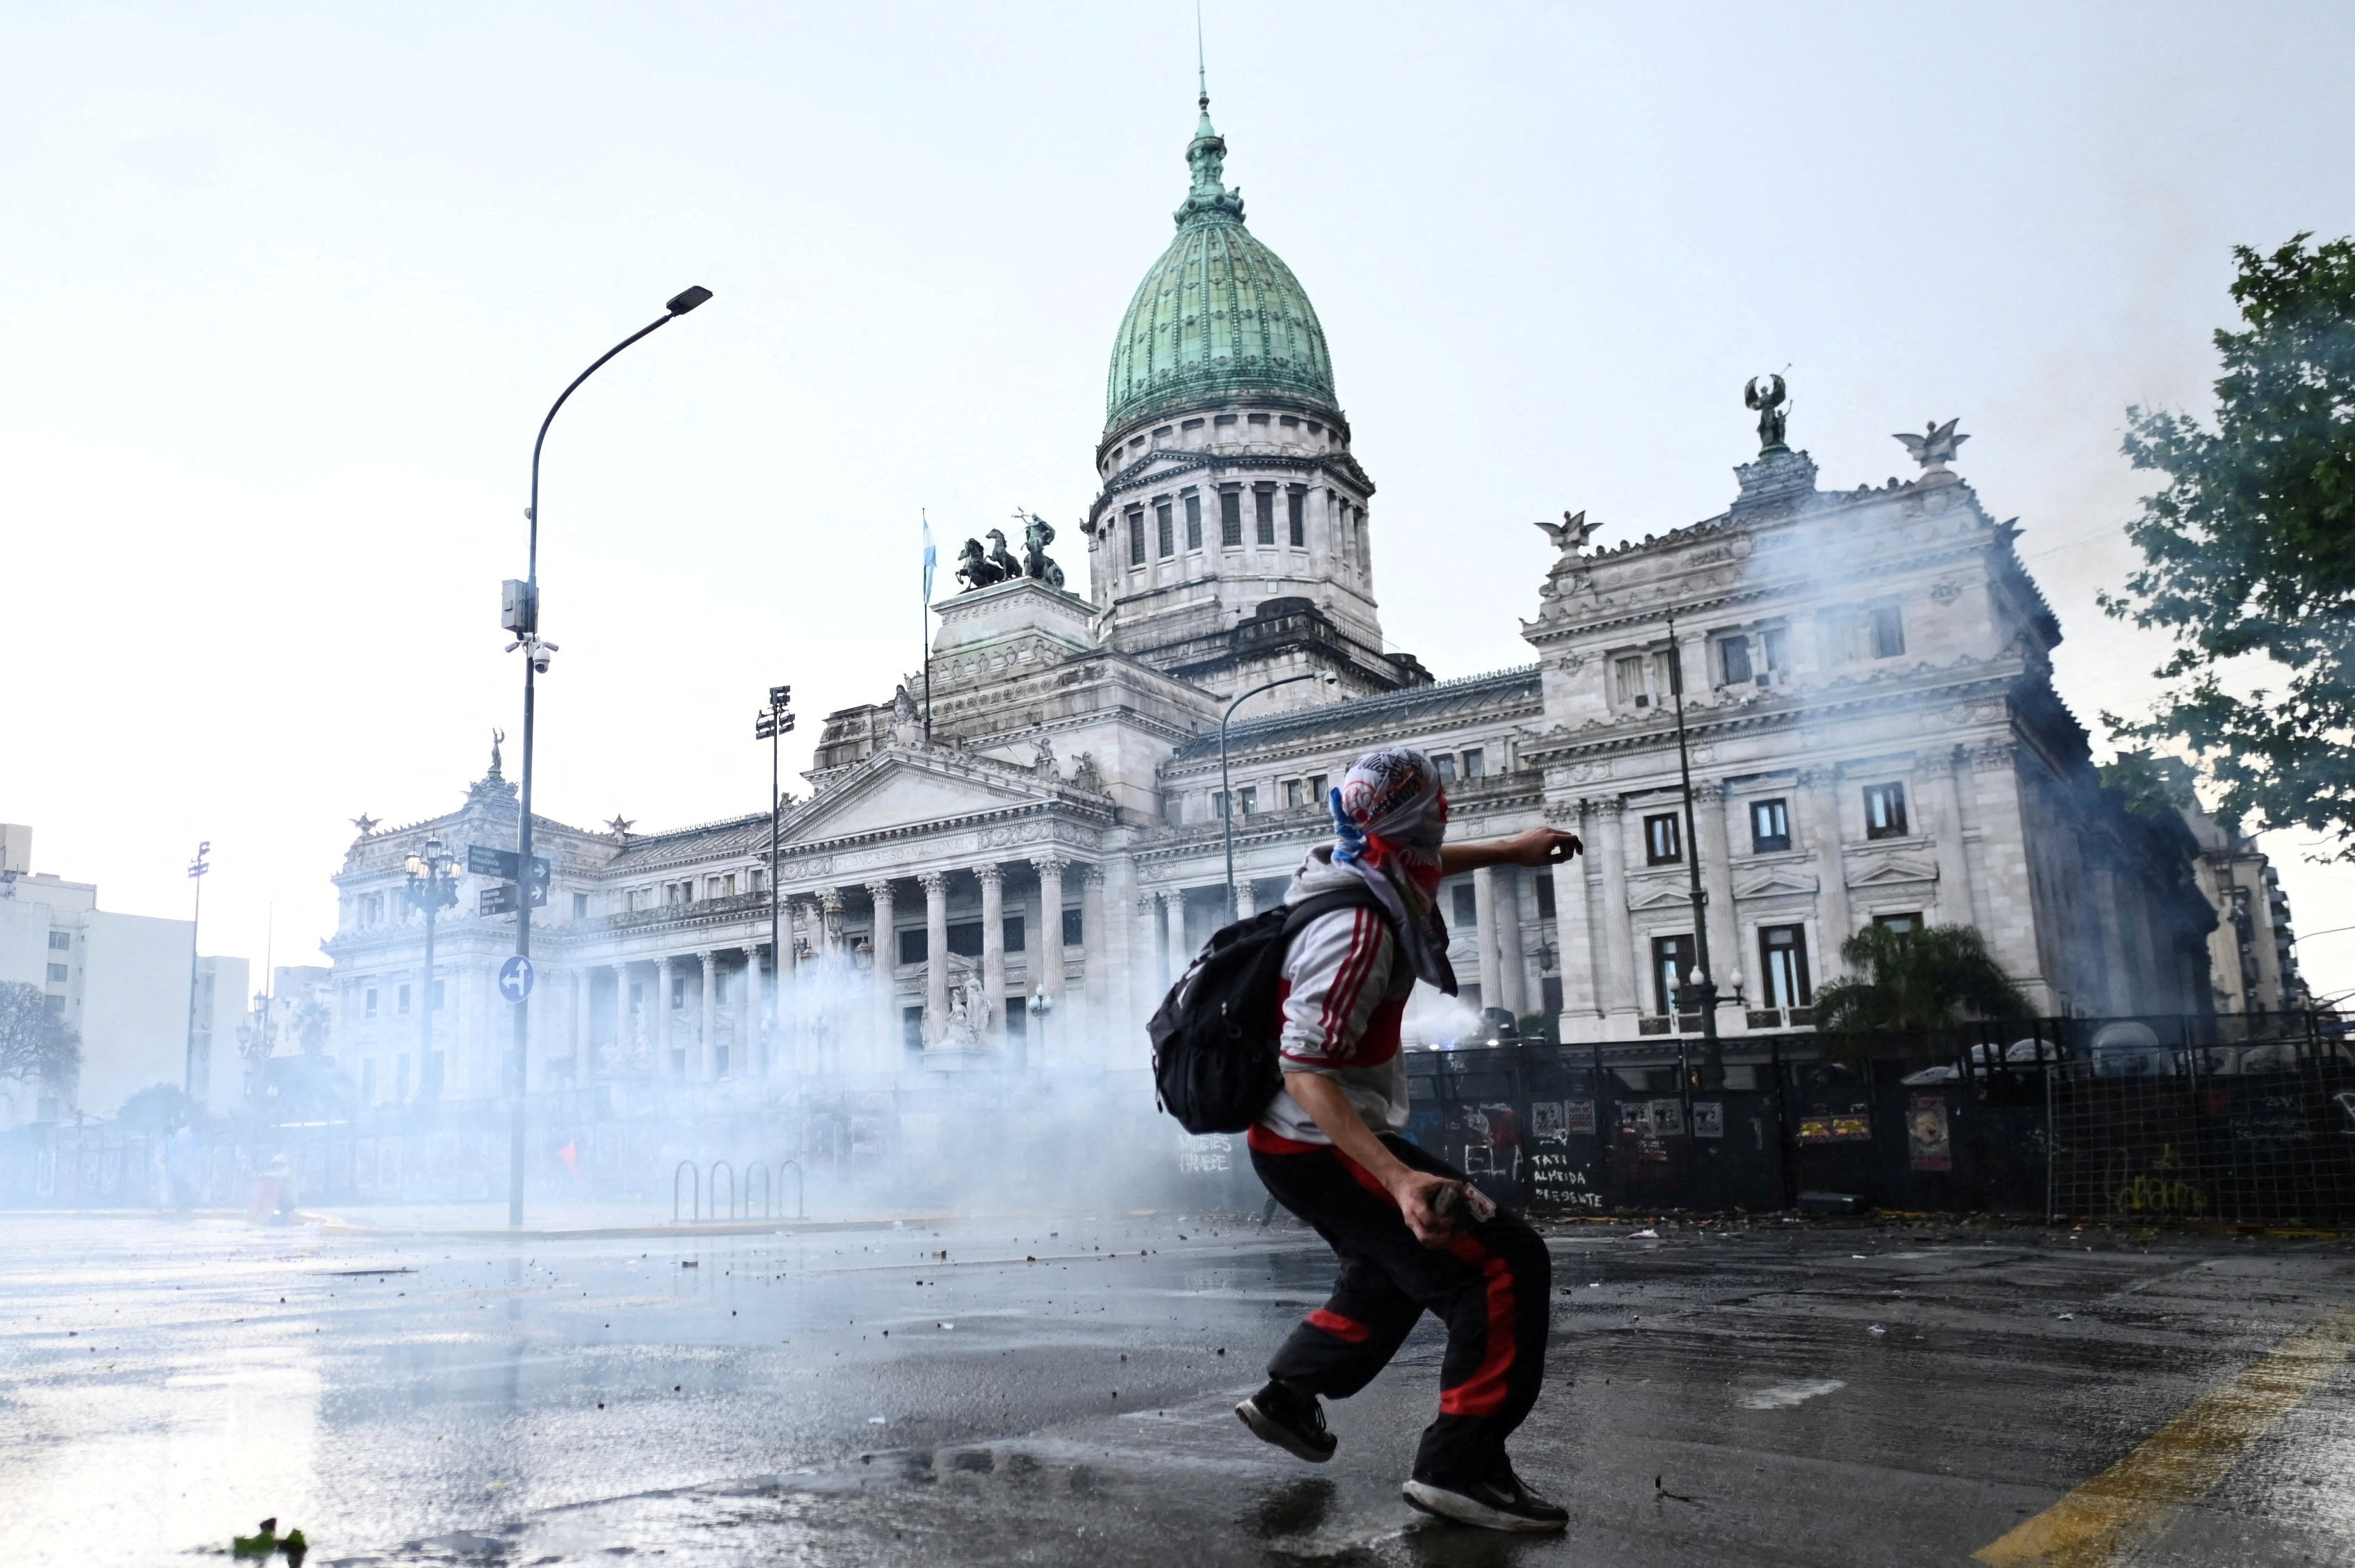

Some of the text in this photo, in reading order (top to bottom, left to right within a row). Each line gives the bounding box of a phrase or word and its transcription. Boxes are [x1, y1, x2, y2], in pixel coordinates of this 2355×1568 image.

[472, 848, 495, 857] Avenida
[844, 839, 968, 868] CONGRESO NACIONAL
[471, 855, 499, 866] Rivadavia
[1532, 1154, 1567, 1167] TATI
[1534, 1170, 1586, 1184] ALMEIDA
